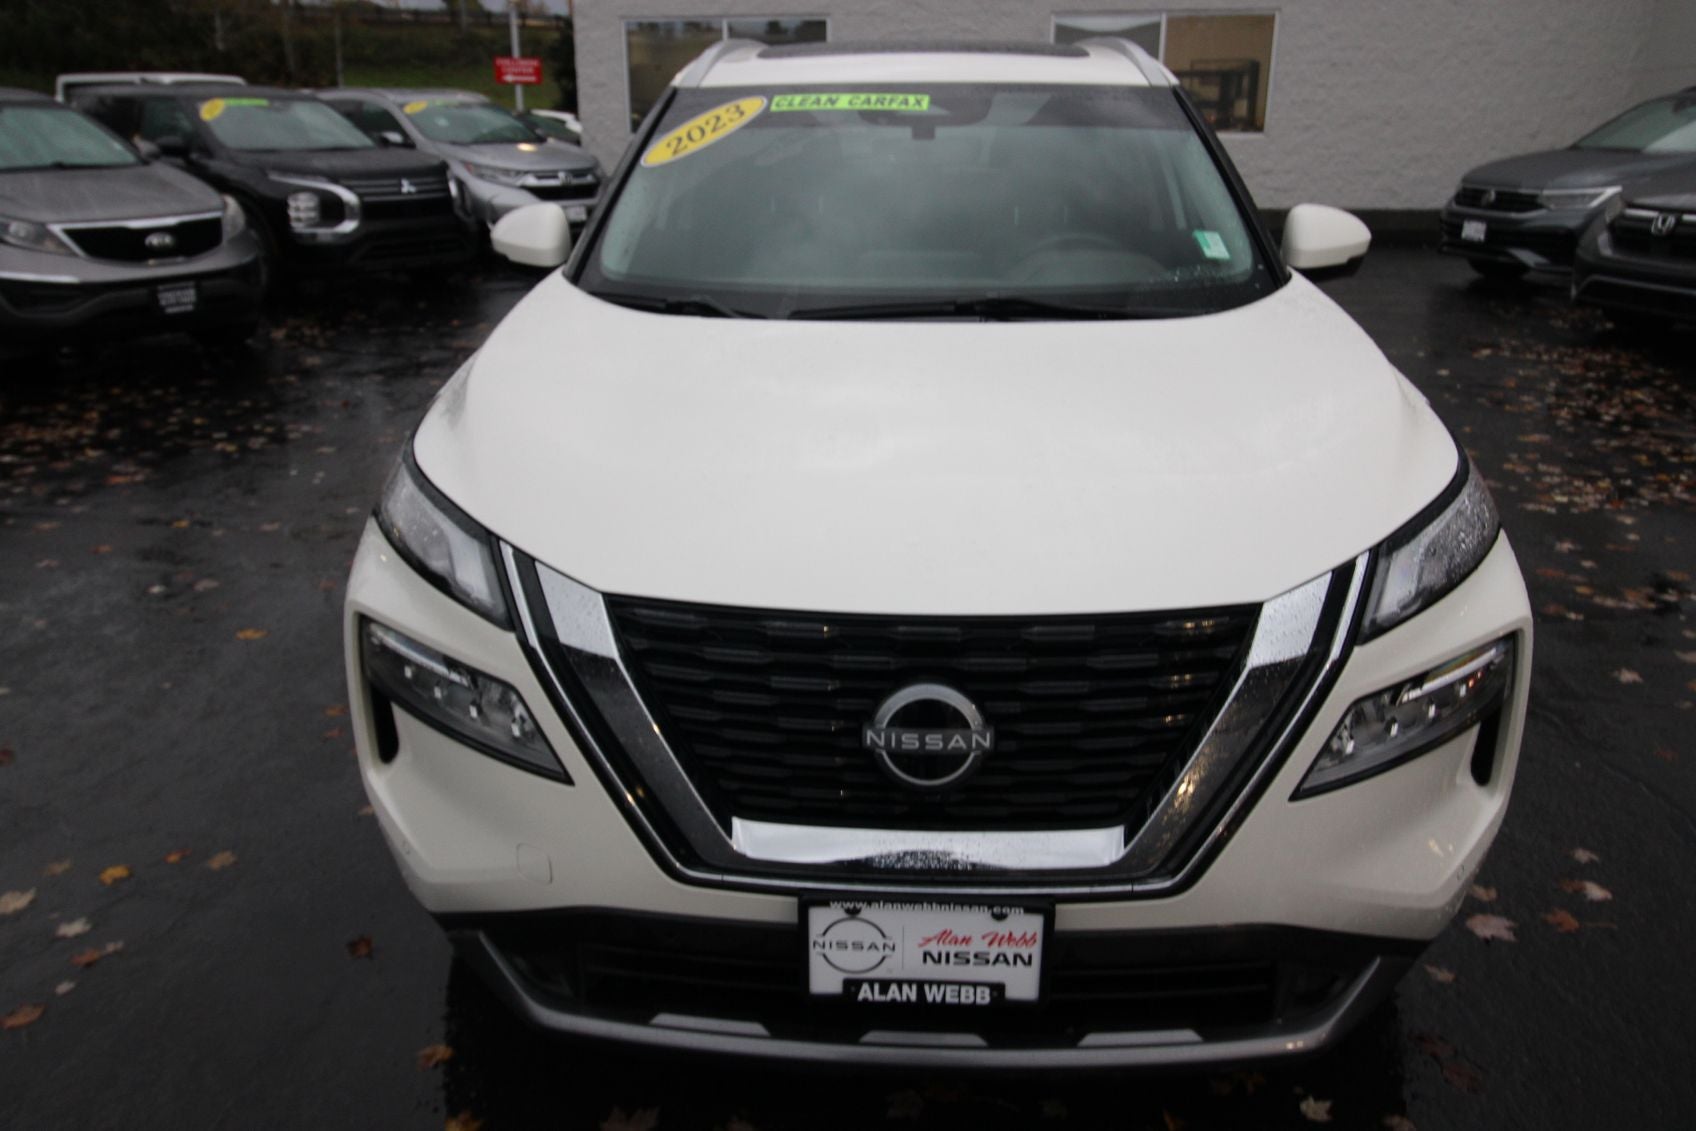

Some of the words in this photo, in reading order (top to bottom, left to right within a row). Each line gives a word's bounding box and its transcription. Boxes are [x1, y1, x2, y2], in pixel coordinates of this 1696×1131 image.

[773, 94, 839, 108] CLEAN
[848, 94, 927, 108] CARFAX
[666, 104, 745, 156] 2023
[866, 730, 990, 750] NISSAN
[829, 901, 1024, 915] www.alanwebbnissan.com
[812, 939, 896, 952] NISSAN
[918, 929, 972, 948] Alan
[981, 931, 1038, 947] Webb
[922, 950, 1033, 967] NISSAN
[856, 982, 917, 1002] ALAN
[924, 984, 991, 1005] WEBB
